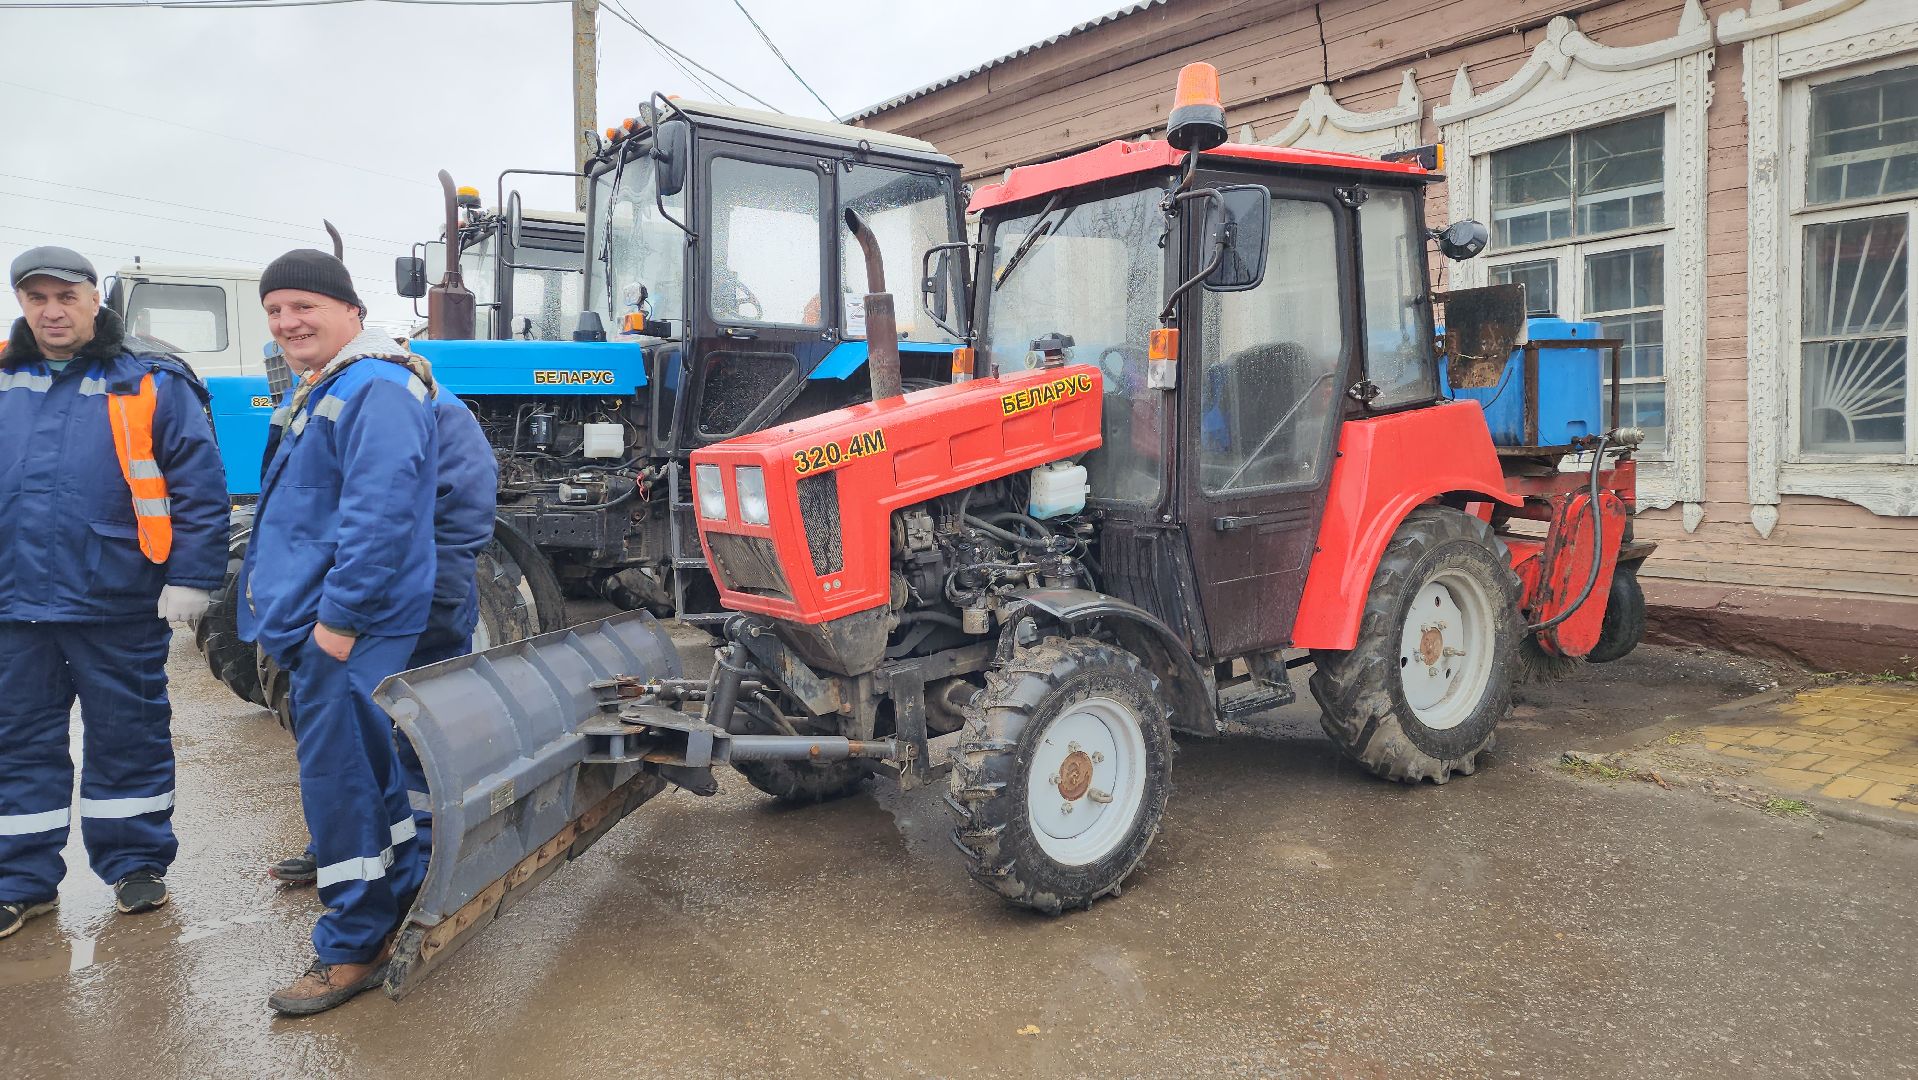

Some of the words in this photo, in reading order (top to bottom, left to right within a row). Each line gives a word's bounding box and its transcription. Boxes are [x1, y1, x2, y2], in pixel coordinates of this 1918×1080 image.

[534, 370, 615, 385] БЕЛАРУС
[252, 396, 273, 408] 82.
[1001, 374, 1092, 416] БЕЛАРУС
